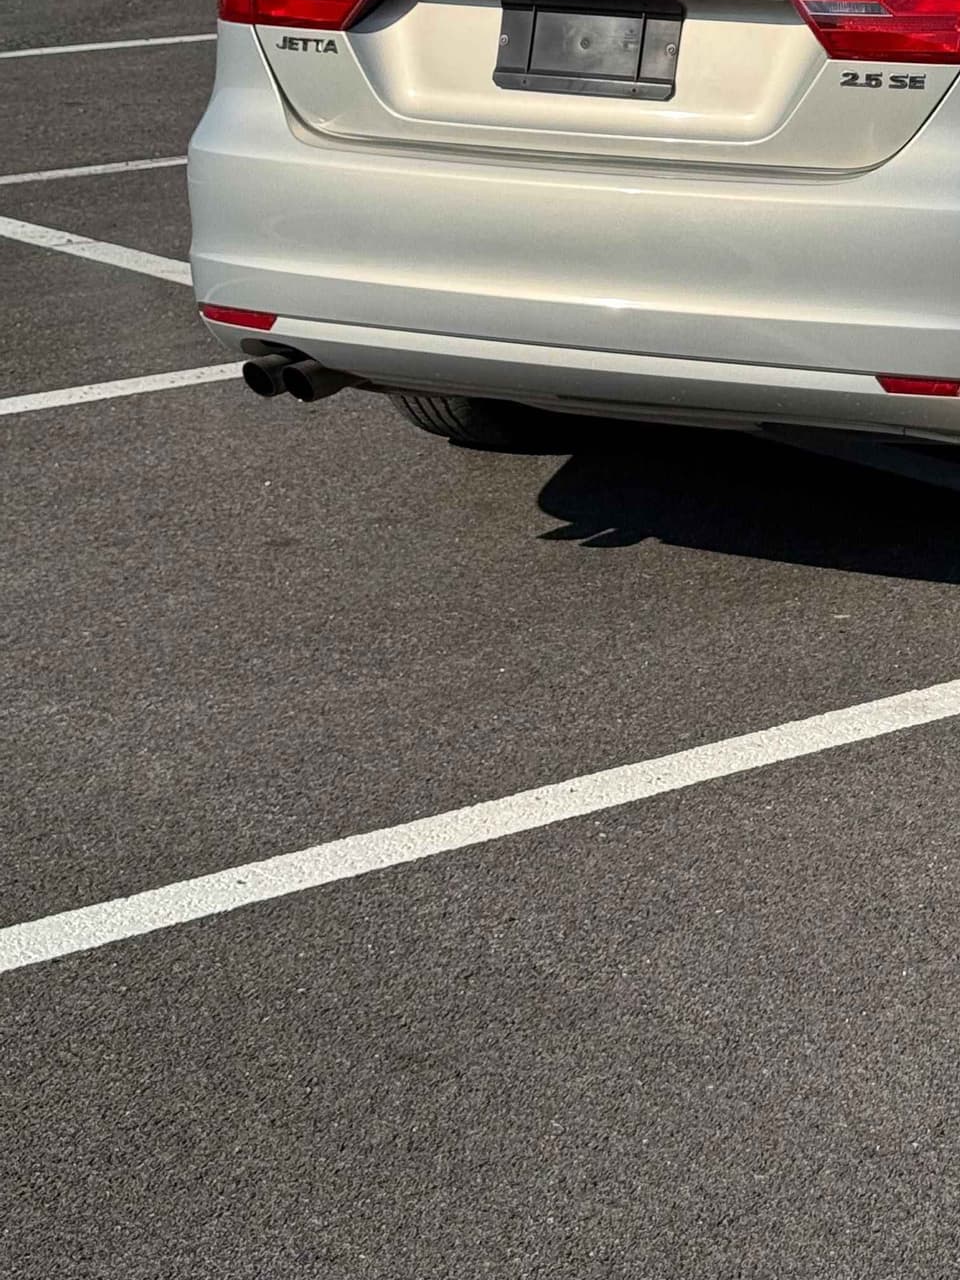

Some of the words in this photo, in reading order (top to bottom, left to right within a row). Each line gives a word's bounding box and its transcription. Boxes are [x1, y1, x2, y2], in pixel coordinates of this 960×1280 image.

[276, 36, 338, 54] JETTA
[840, 72, 883, 88] 2.5
[888, 73, 927, 89] SE
